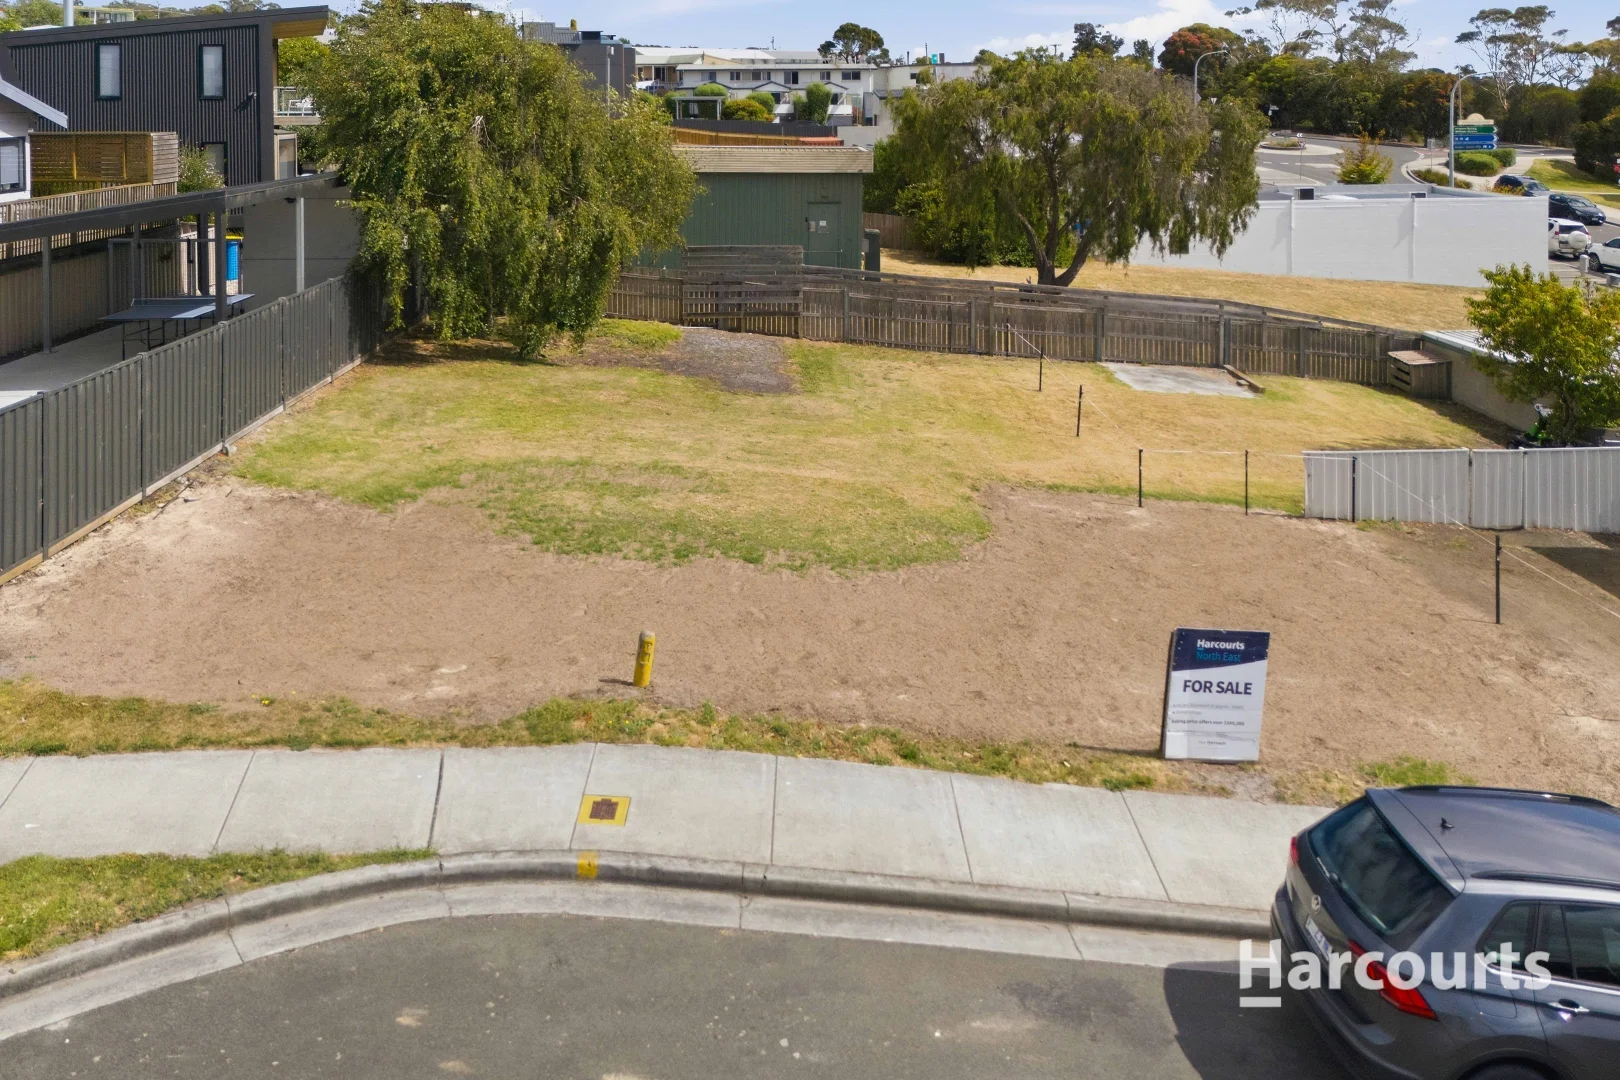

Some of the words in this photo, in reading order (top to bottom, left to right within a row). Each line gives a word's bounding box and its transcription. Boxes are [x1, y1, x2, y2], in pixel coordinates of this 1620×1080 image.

[1197, 639, 1245, 650] Harcourts
[1196, 652, 1220, 661] North
[1223, 652, 1241, 662] East
[1183, 680, 1213, 693] FOR
[1216, 681, 1253, 695] SALE
